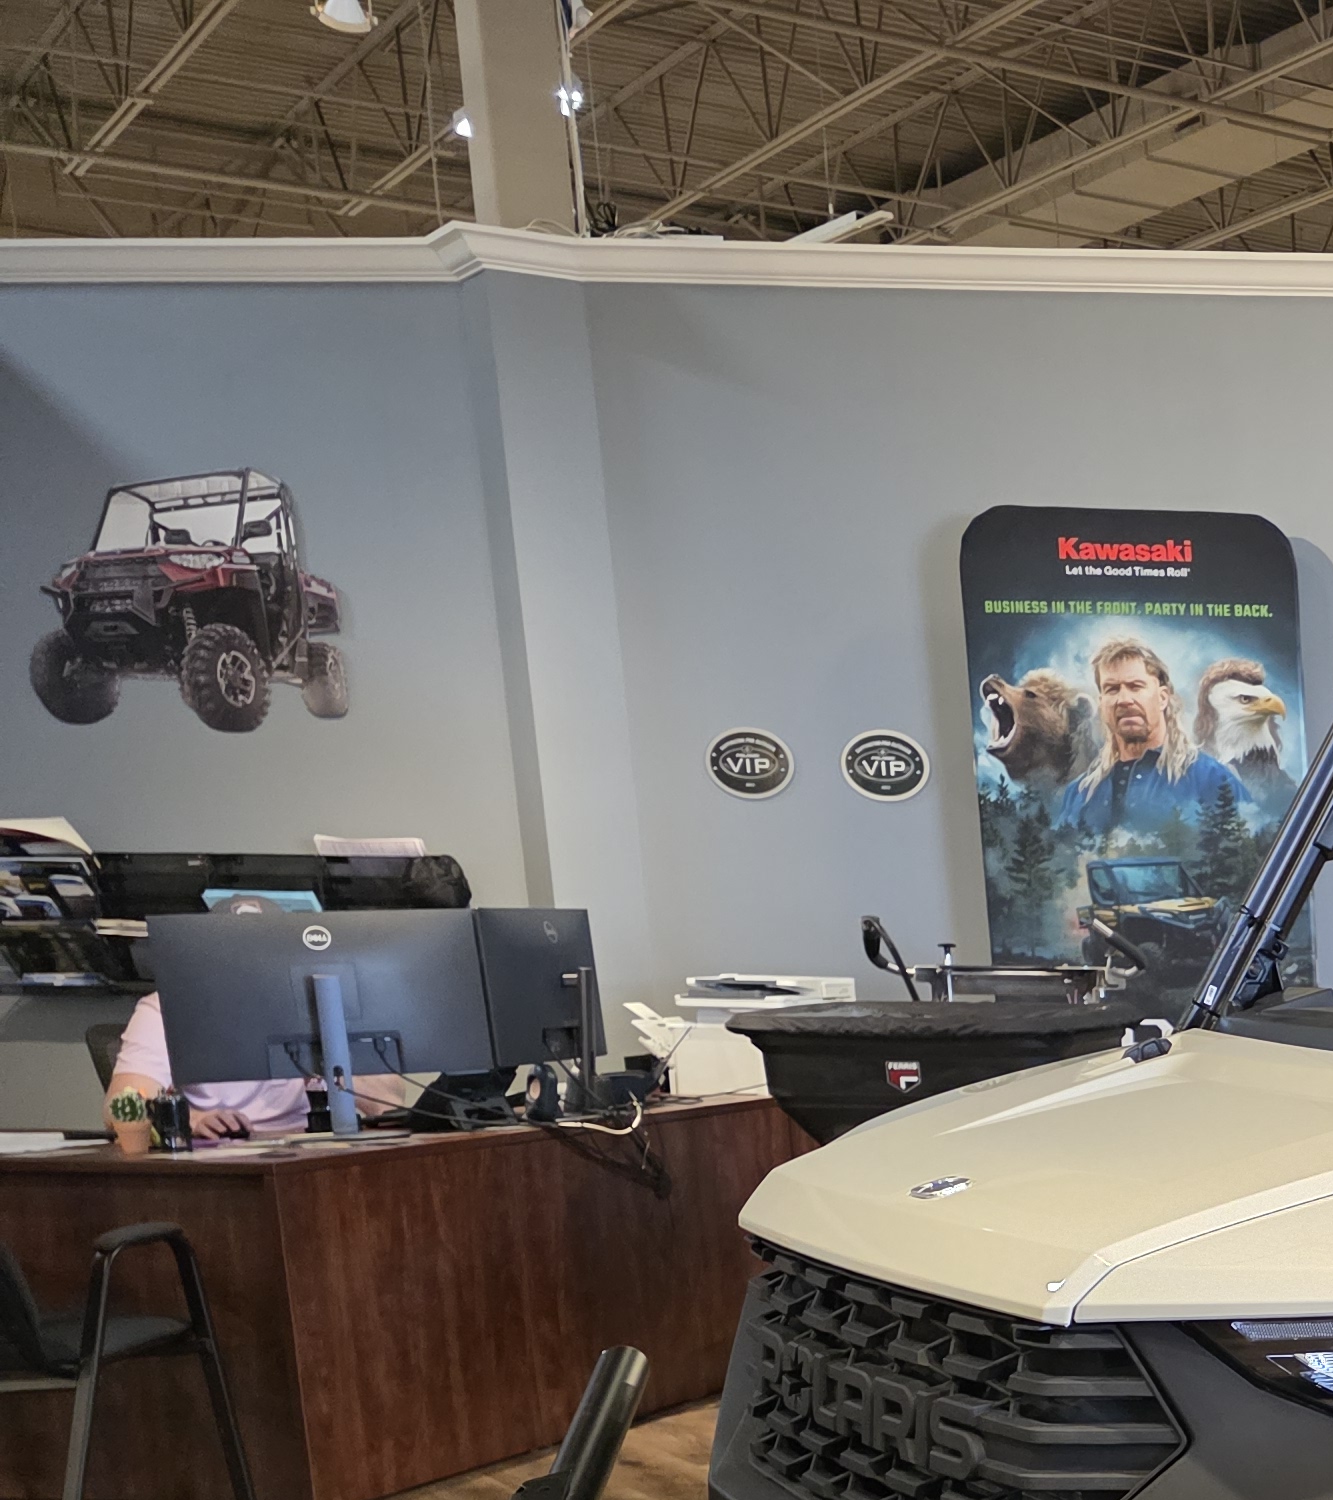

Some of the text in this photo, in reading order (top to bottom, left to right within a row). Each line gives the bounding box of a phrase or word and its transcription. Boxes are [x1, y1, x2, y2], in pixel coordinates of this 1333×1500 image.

[1058, 537, 1193, 562] Kawasaki
[1065, 565, 1084, 576] Let
[1085, 566, 1102, 576] the
[1104, 566, 1132, 577] Good
[1134, 566, 1165, 578] Times
[984, 600, 1273, 618] BUSINESS IN THE FRONT. PARTY IN THE BACK.
[726, 757, 771, 774] VIP
[862, 759, 906, 777] VIP
[888, 1061, 918, 1071] FERRIS
[752, 1330, 986, 1482] POLARIS
